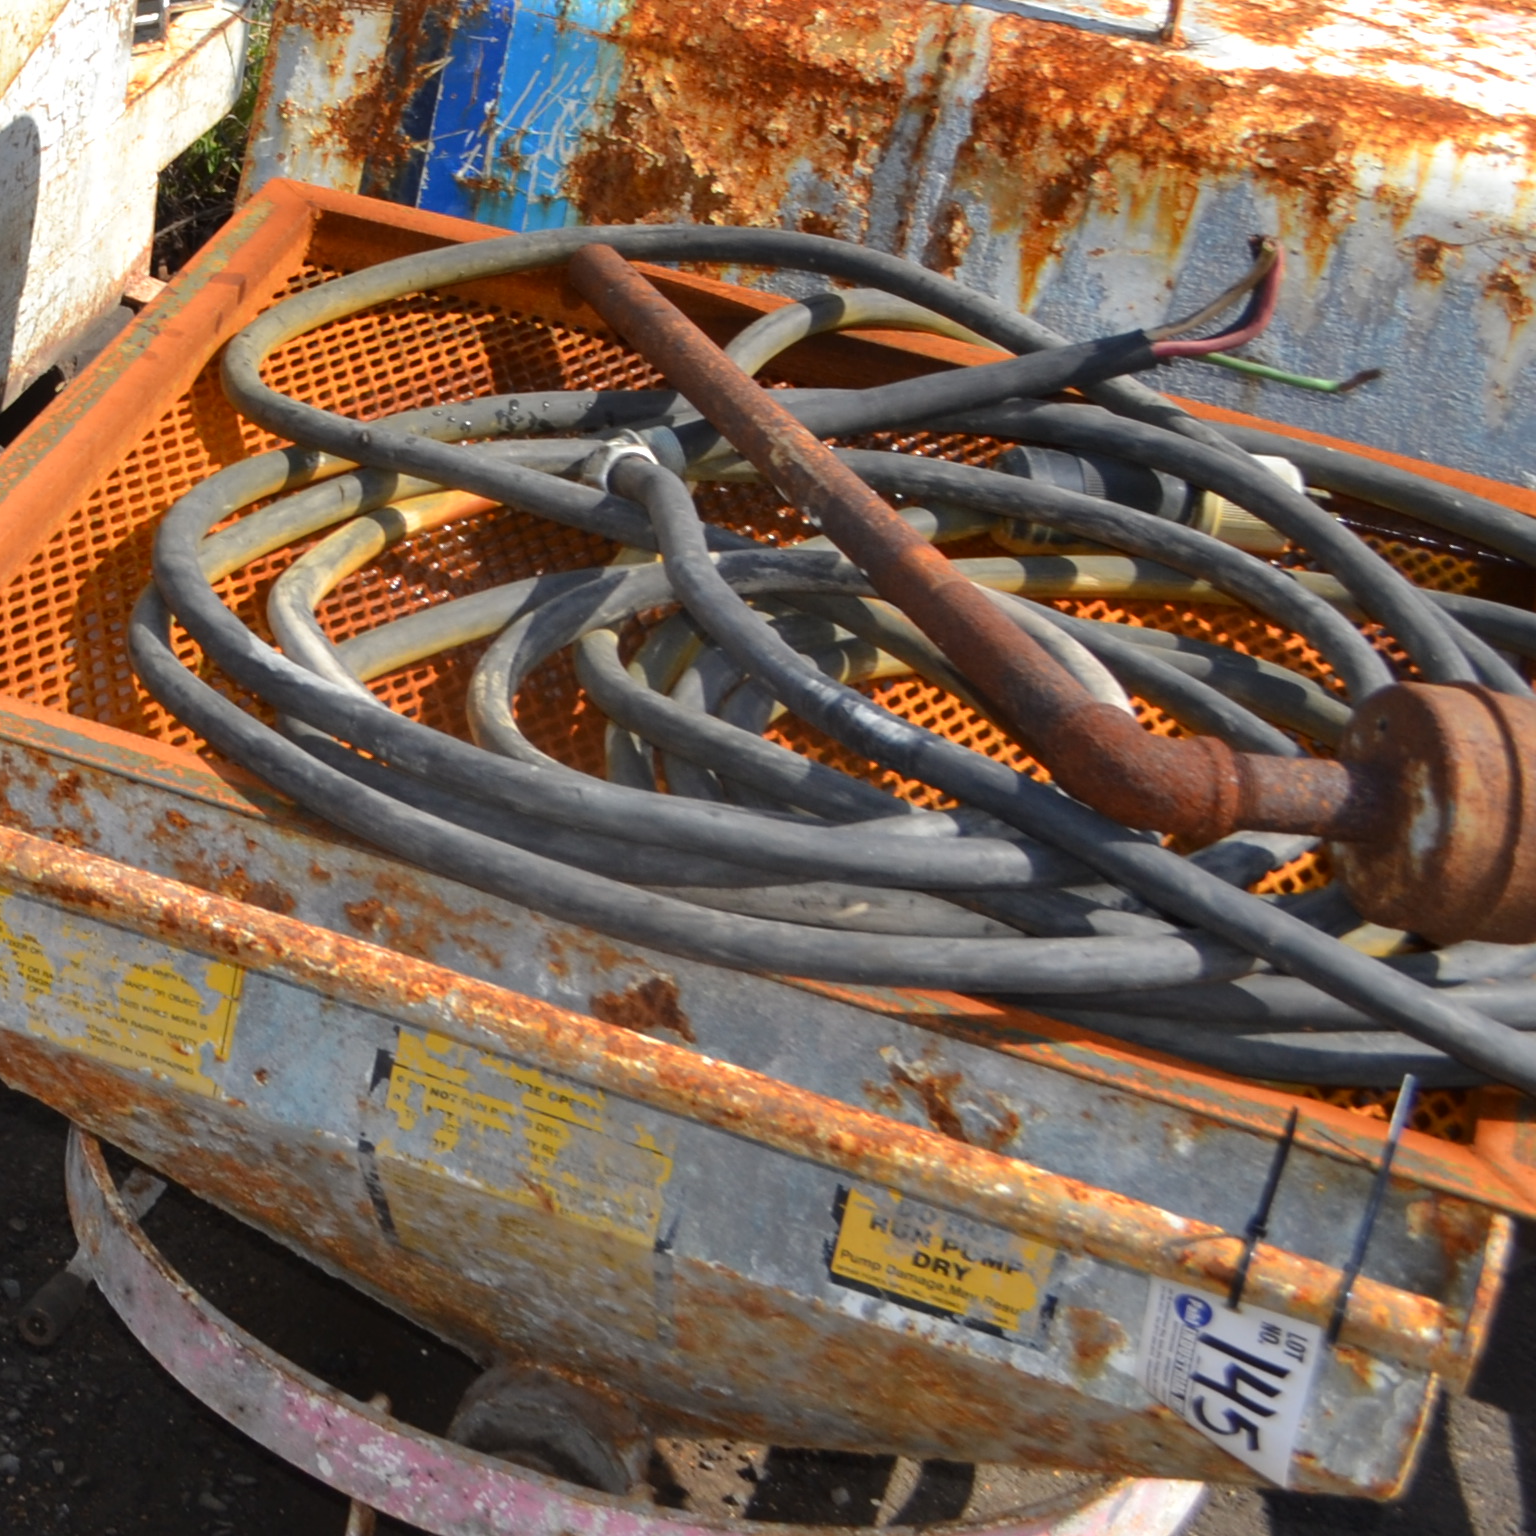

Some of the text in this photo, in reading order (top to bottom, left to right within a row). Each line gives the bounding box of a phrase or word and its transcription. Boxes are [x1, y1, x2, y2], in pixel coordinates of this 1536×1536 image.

[840, 1249, 882, 1271] Pump
[983, 1294, 1021, 1314] Resu
[912, 1250, 972, 1281] DRY
[1258, 1321, 1282, 1345] NO.
[1284, 1330, 1308, 1362] LOT
[1189, 1332, 1291, 1452] 145
